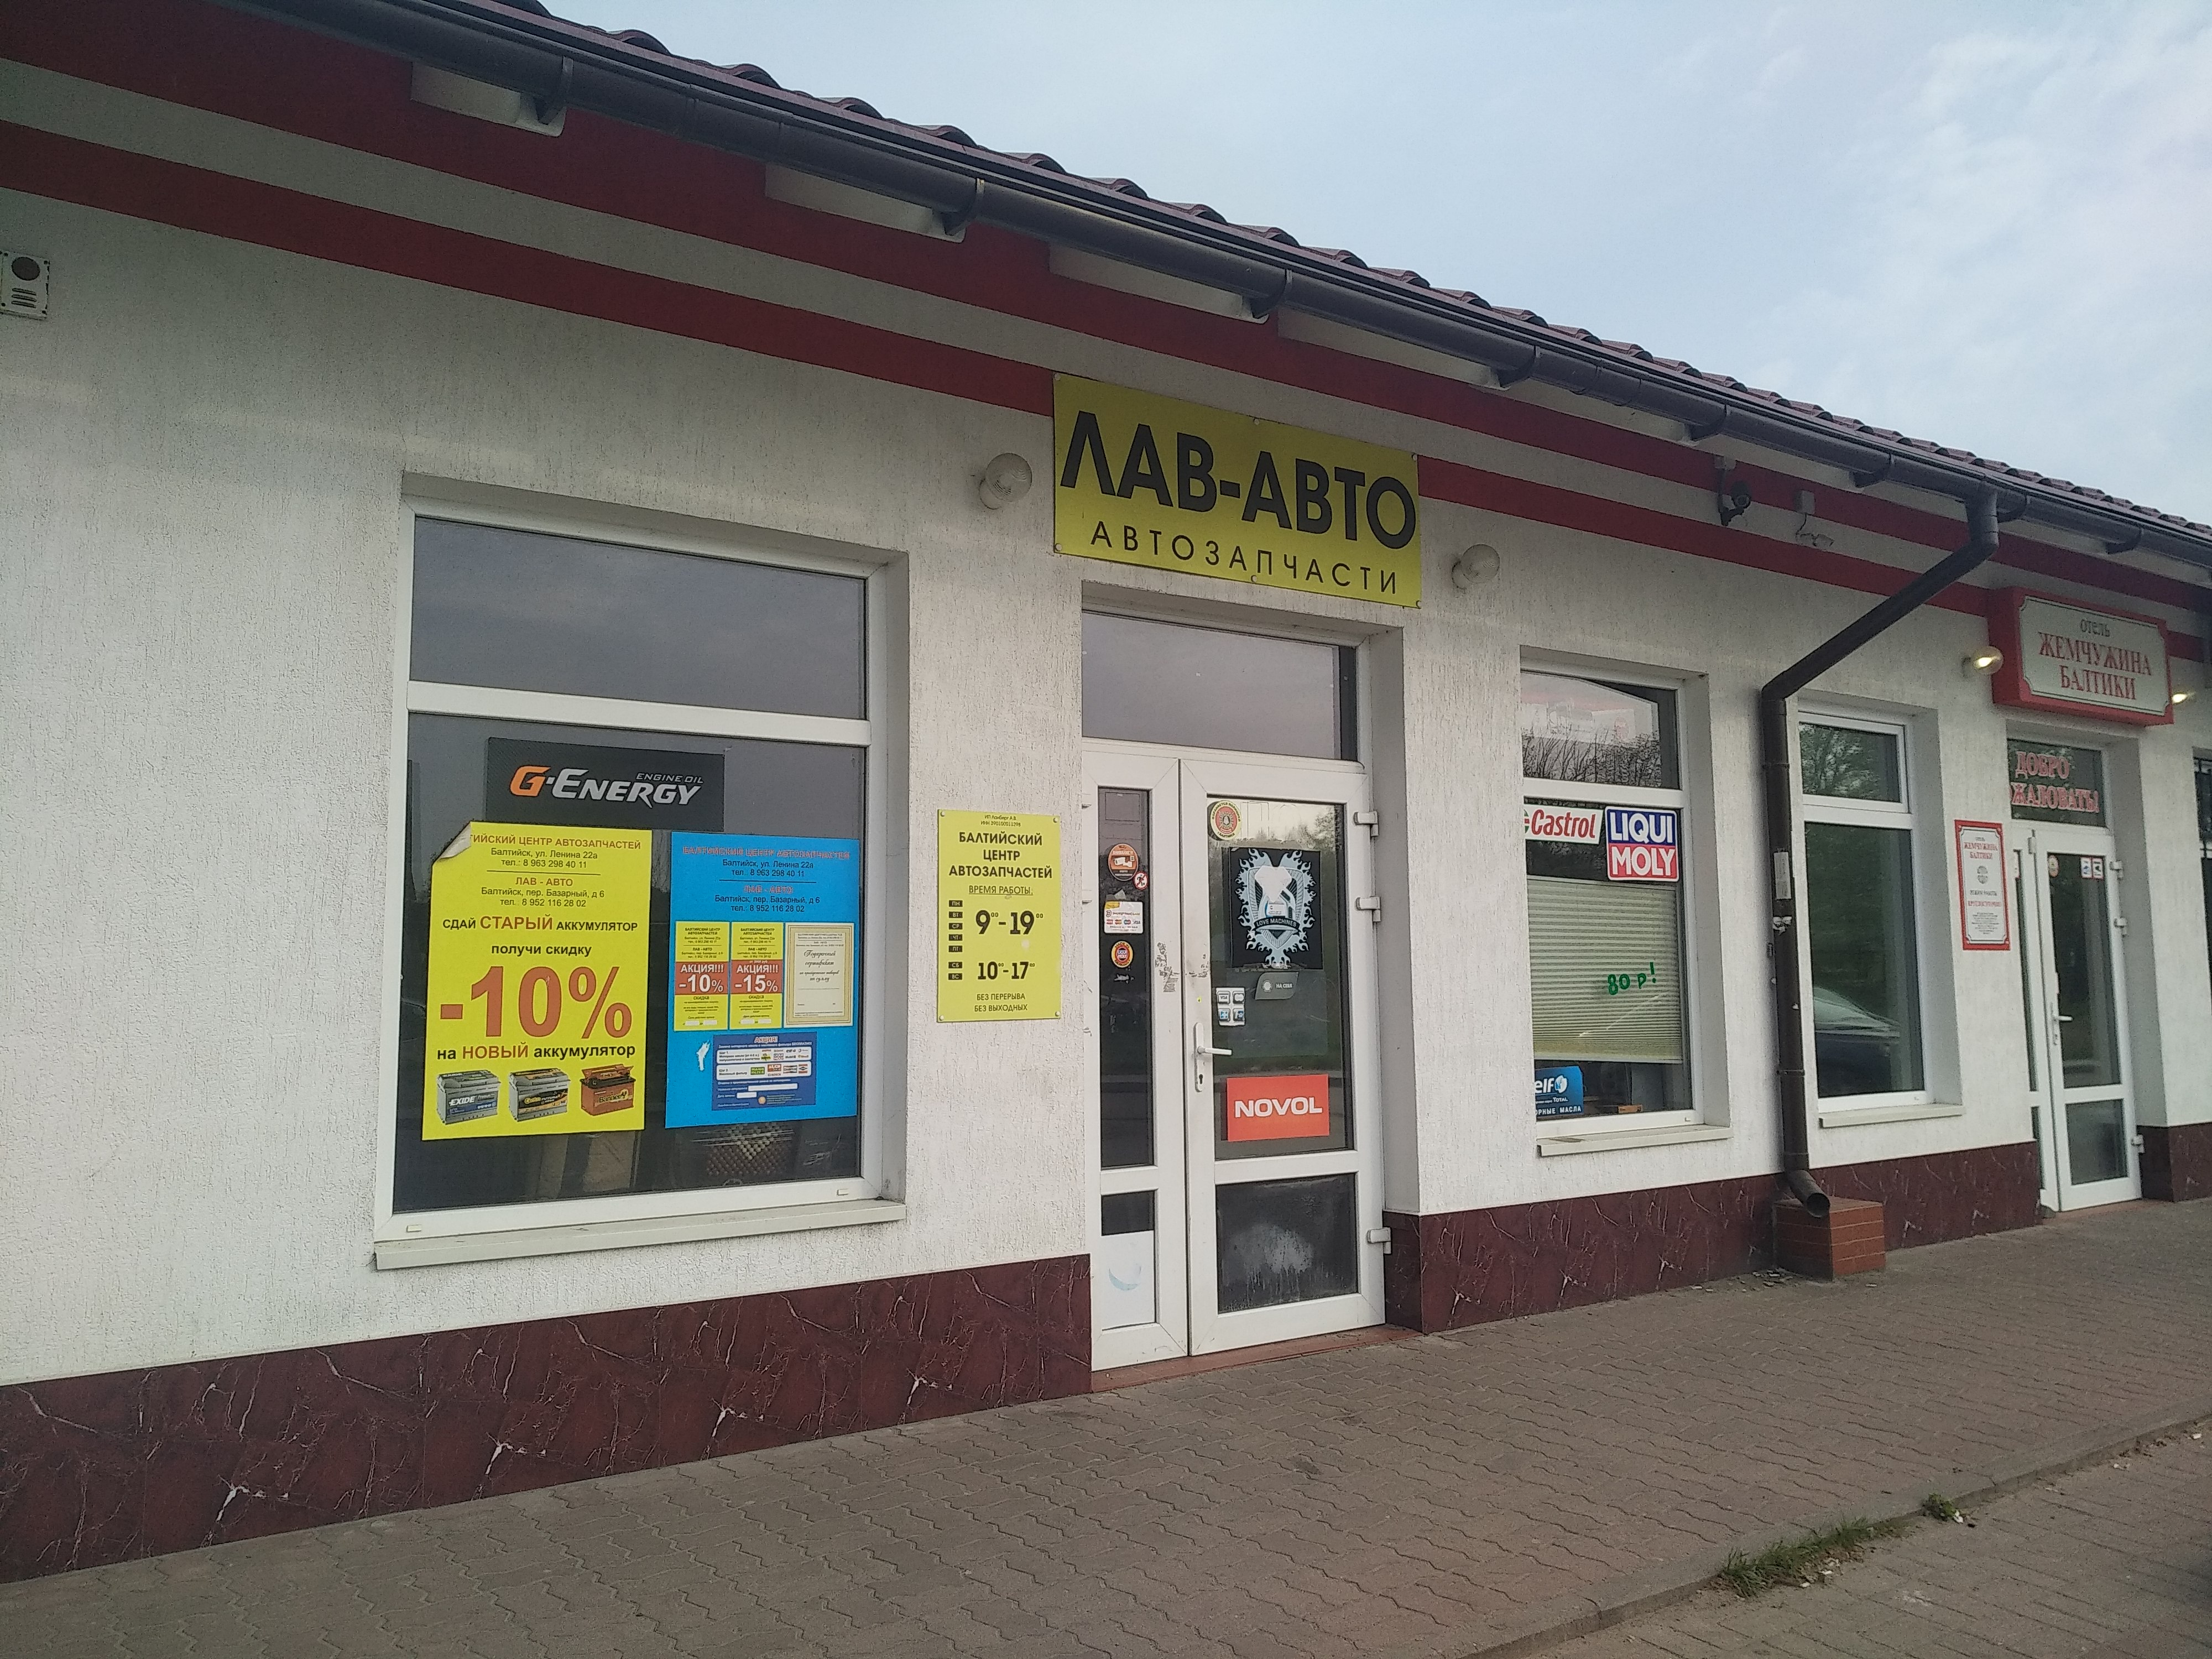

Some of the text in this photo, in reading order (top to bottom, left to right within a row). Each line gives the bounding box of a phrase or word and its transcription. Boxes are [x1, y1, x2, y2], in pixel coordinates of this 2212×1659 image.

[1060, 411, 1416, 549] ЛАВ-АВТО
[1091, 521, 1395, 594] АВТОЗАПЧАСТИ
[2038, 632, 2152, 676] ЖЕМЧУЖИНА
[2059, 665, 2136, 700] БАЛТИКИ
[2015, 751, 2070, 779] ДОБРО
[636, 773, 683, 782] ENGINE
[2010, 781, 2100, 813] ЖАЛОВАТЬ!
[1531, 809, 1596, 838] Castrol
[1610, 812, 1673, 844] LIQUI
[519, 837, 552, 846] ЦЕНТР
[555, 838, 641, 849] АВТОЗАПЧАСТЕЙ
[959, 831, 1042, 846] БАЛТИЙСКИЙ
[491, 848, 533, 857] Балтийск,
[745, 848, 774, 857] ЦЕНТР
[983, 849, 1020, 862] ЦЕНТР
[723, 859, 758, 868] Балтийск,
[1611, 846, 1676, 876] MOLY
[948, 865, 1052, 879] АВТОЗАПЧАСТЕЙ
[515, 877, 537, 885] ЛАВ
[481, 887, 524, 896] Балтийск,
[546, 889, 589, 898] Базарный,
[969, 885, 996, 894] ВРЕМЯ
[714, 895, 751, 903] Балтийск,
[770, 895, 807, 905] Базарный,
[443, 914, 638, 931] СДАЙ СТАРЫЙ АККУМУЛЯТОР
[1256, 918, 1297, 927] LOVE MACHINES
[491, 945, 592, 957] получи скидку
[680, 964, 724, 974] АКЦИЯ!!!
[737, 964, 778, 974] АКЦИЯ!!!
[679, 974, 723, 993] -10%
[734, 974, 778, 992] -15%
[1608, 974, 1630, 995] 80
[440, 966, 632, 1039] -10%
[437, 1042, 635, 1060] на НОВЫЙ аккумулятор
[1535, 1078, 1554, 1093] elf
[450, 1095, 477, 1106] EXIDE
[599, 1094, 622, 1103] Banner
[1234, 1097, 1323, 1118] NOVOL
